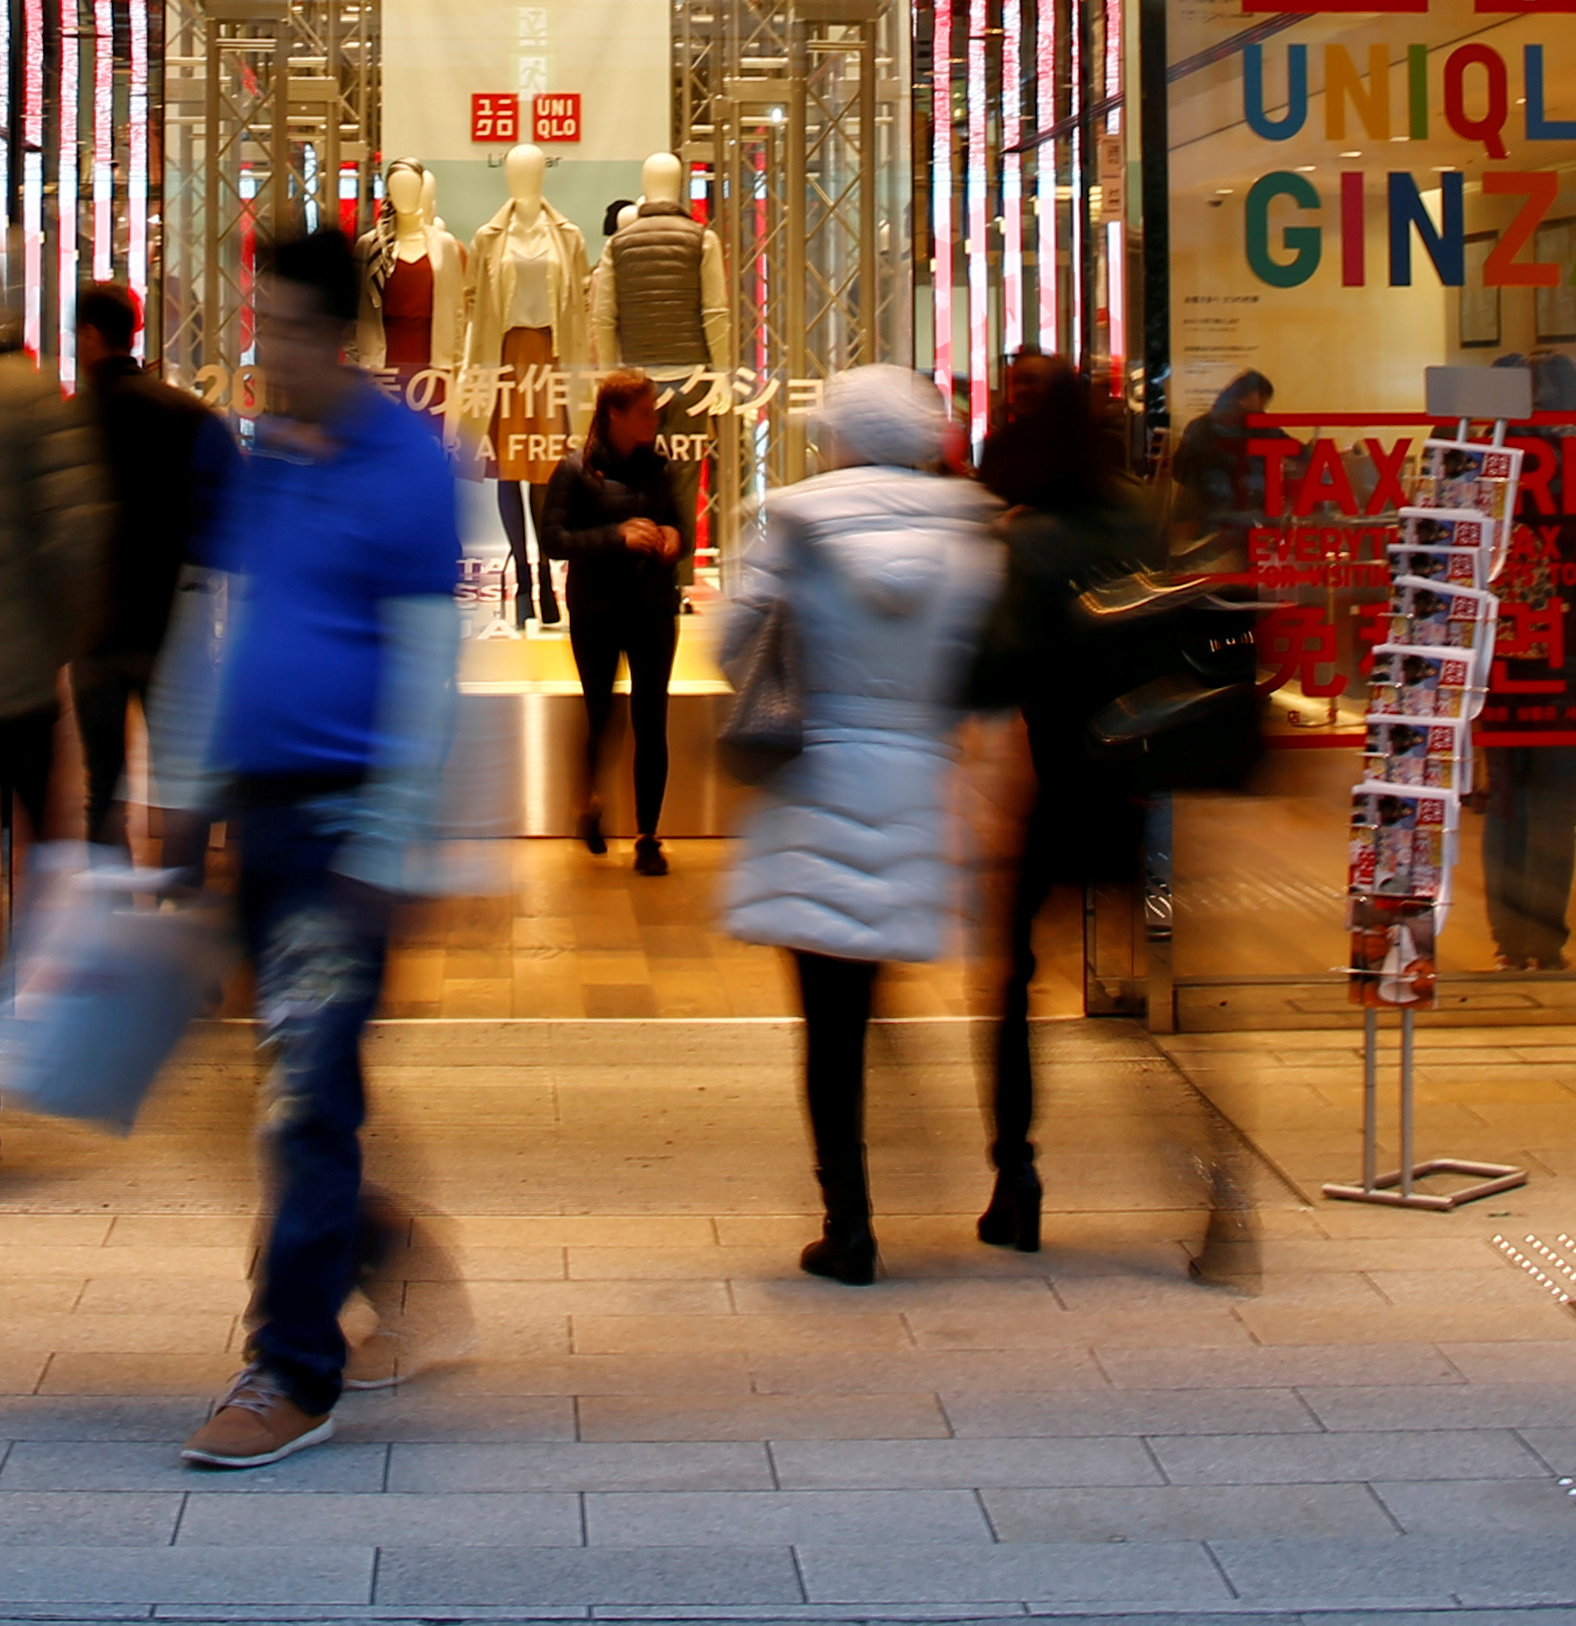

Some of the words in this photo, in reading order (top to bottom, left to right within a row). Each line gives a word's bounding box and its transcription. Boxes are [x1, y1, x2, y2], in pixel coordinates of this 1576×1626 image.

[536, 99, 573, 117] UNI
[536, 119, 576, 139] QLO
[508, 434, 582, 462] FRES
[1247, 437, 1413, 518] TAX
